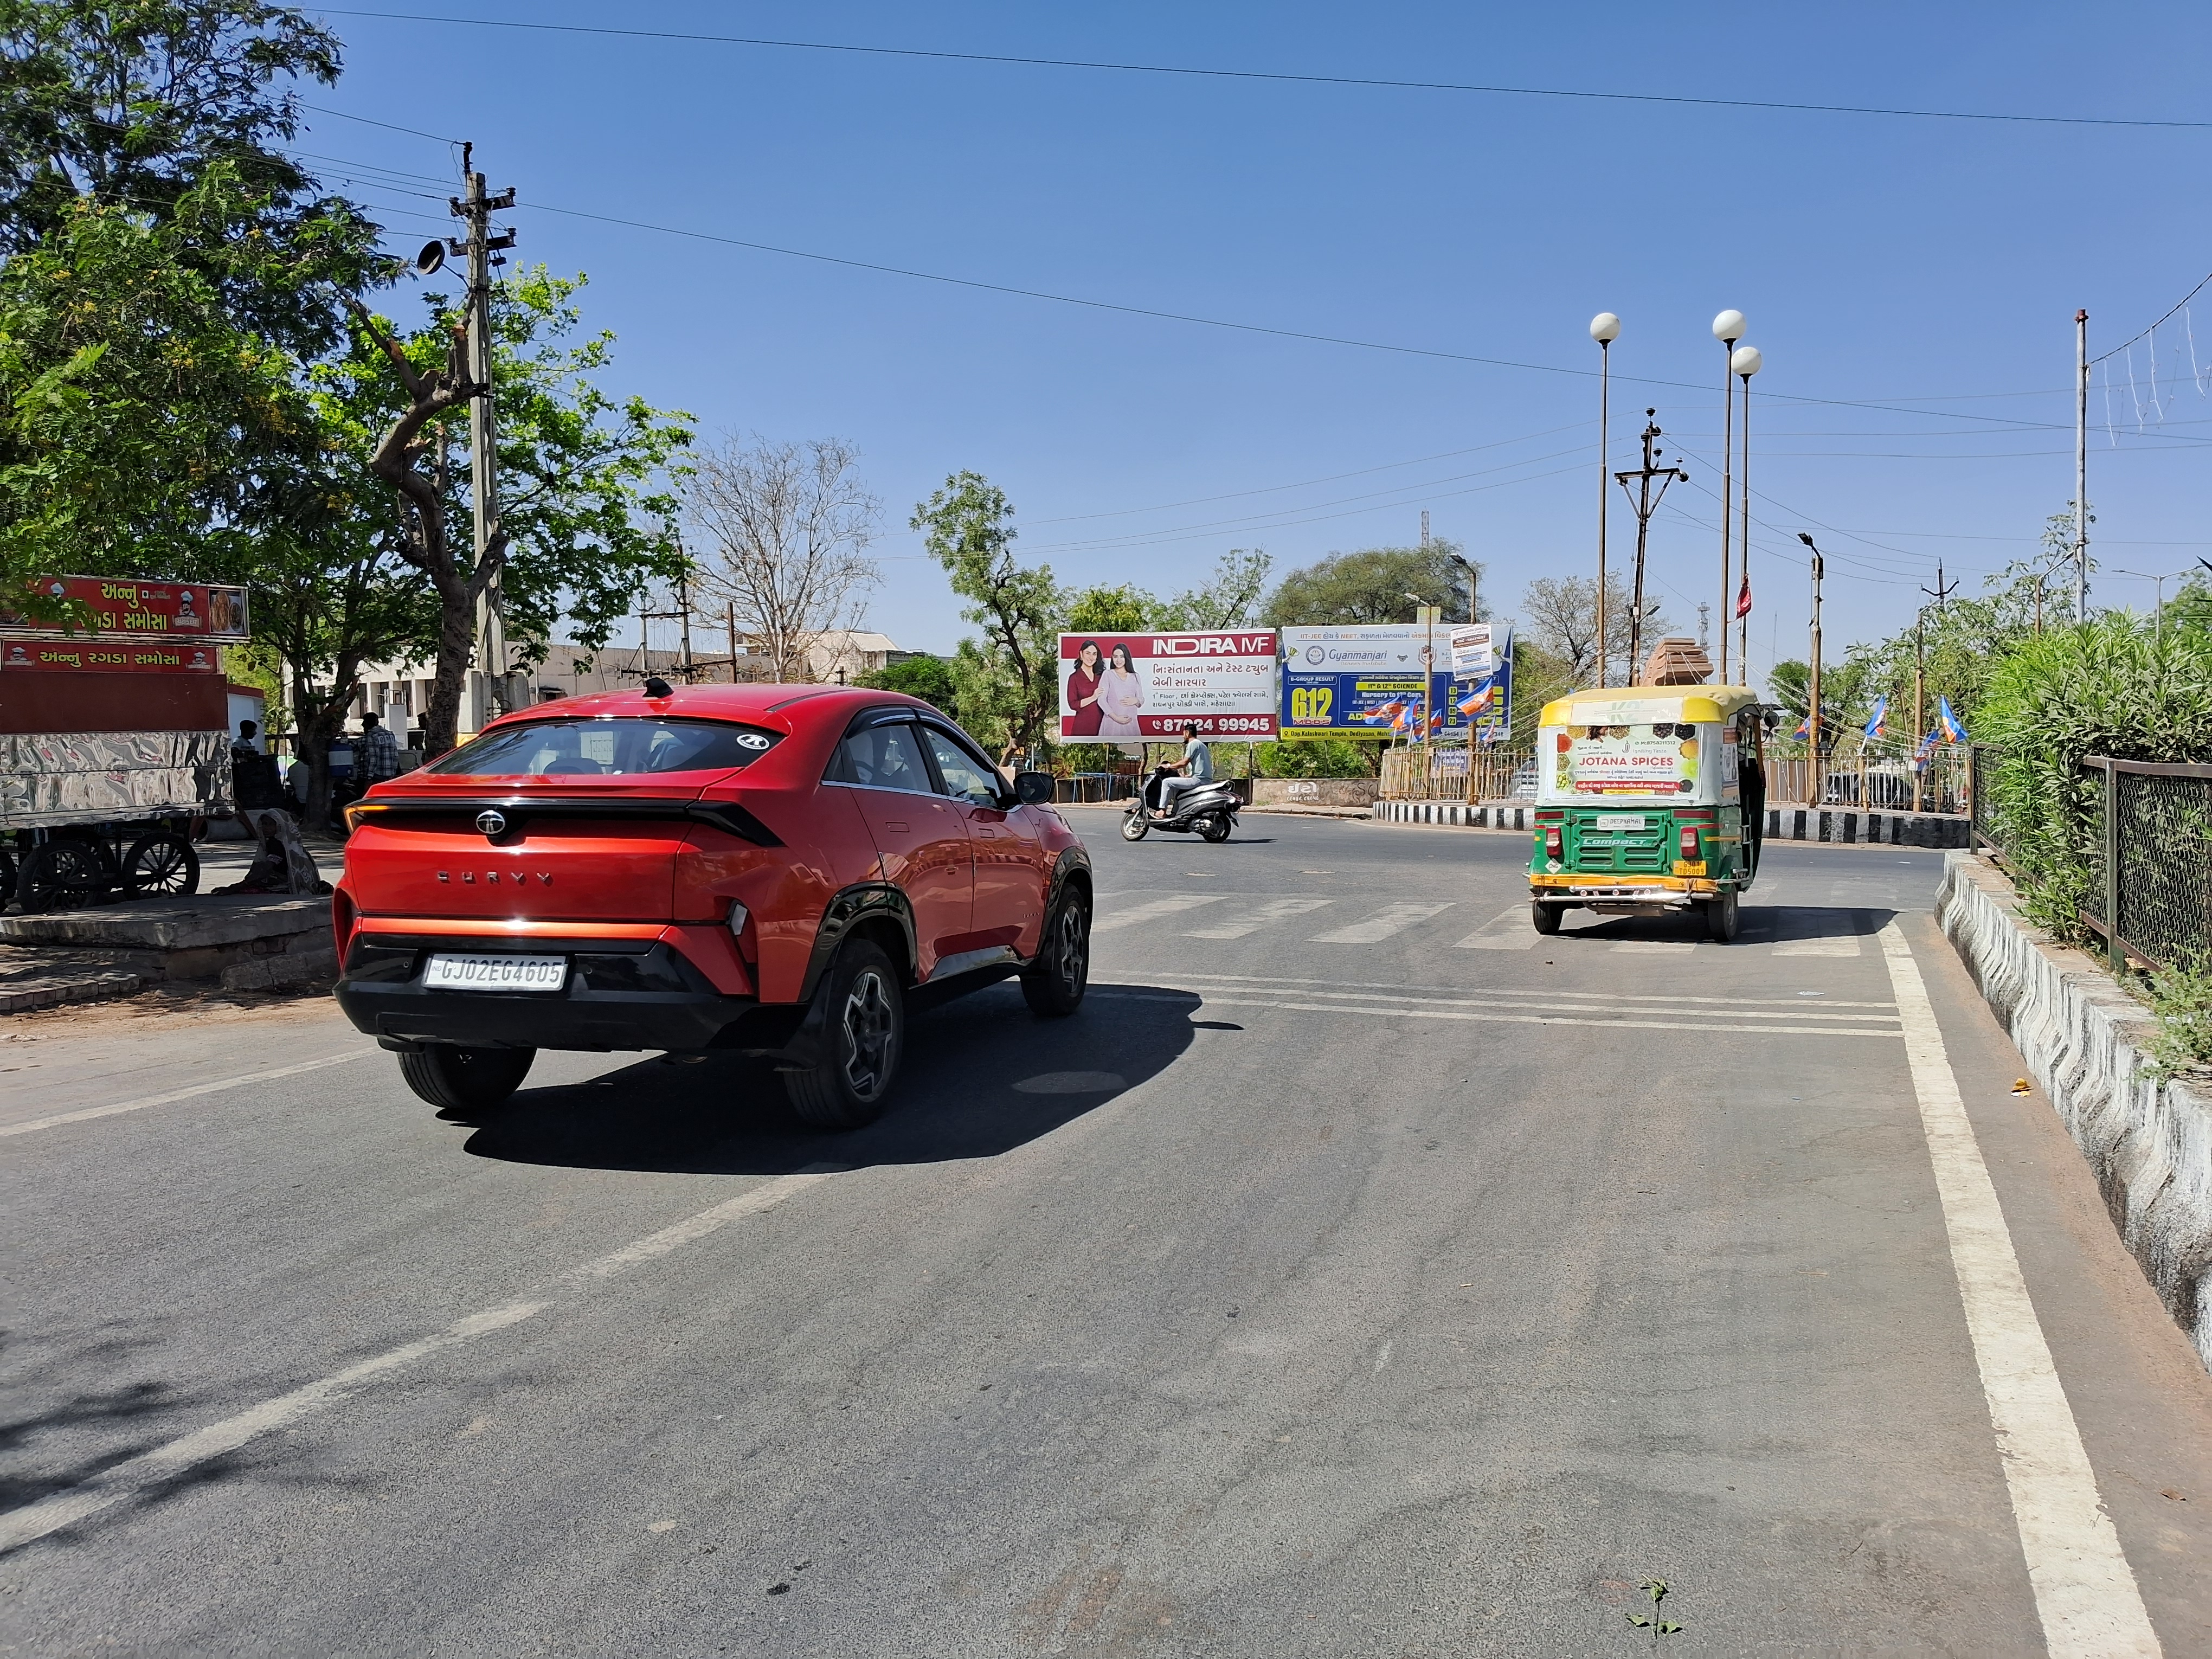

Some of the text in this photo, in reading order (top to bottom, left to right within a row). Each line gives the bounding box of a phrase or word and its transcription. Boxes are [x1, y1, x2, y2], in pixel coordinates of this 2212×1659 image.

[101, 582, 139, 609] અન્નુ
[124, 606, 167, 631] સમોસા
[1153, 636, 1270, 655] INDIRA IVF
[39, 651, 180, 668] અન્નુ રગડા સમોસા
[1329, 648, 1387, 661] Gyanmanjari
[1206, 662, 1223, 673] અને
[1226, 662, 1243, 673] ટેસ્ટ
[1153, 676, 1206, 687] બેબી સારવાર
[1292, 687, 1333, 720] 612
[1218, 718, 1269, 731] 99945
[1579, 757, 1674, 766] JOTANA SPICES
[442, 959, 562, 983] GJ02EG4605
